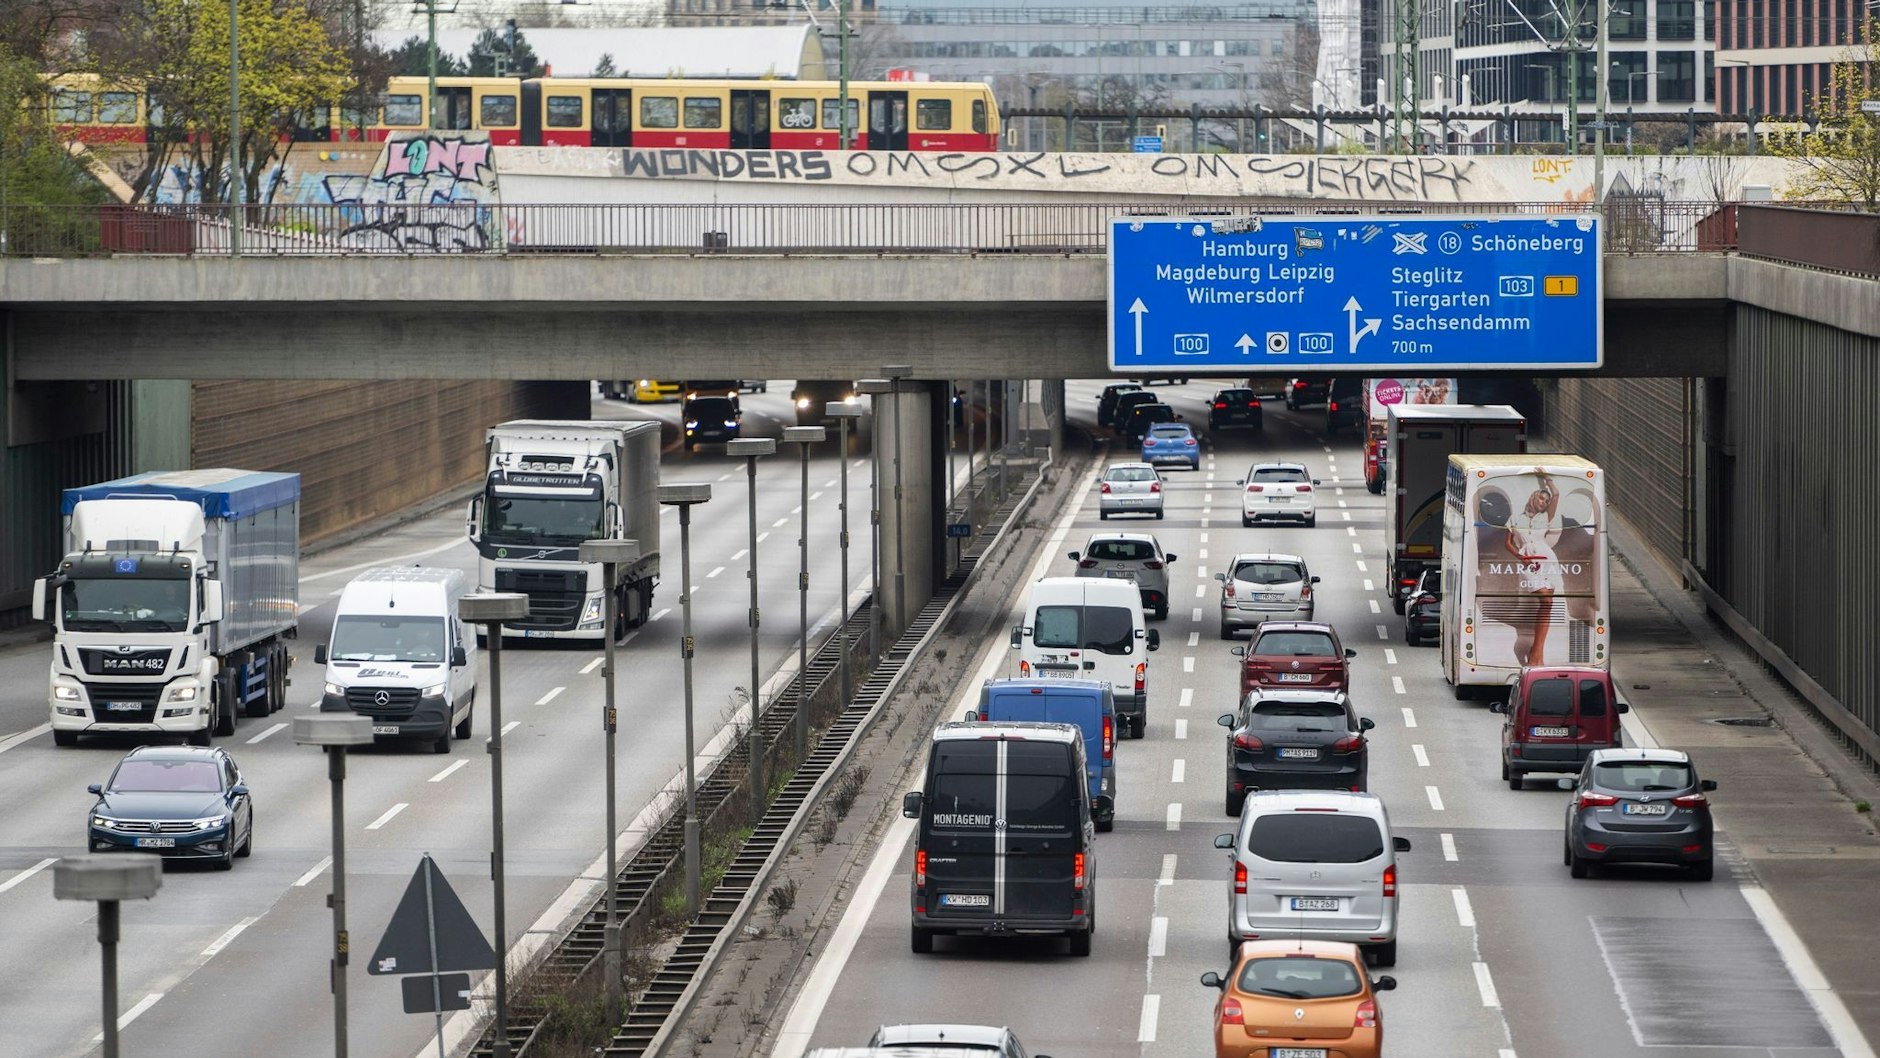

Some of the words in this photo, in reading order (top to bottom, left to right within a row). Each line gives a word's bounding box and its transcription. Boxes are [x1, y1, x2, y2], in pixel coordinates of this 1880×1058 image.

[622, 149, 832, 180] WONDERS
[1202, 240, 1288, 260] Hamburg
[1442, 237, 1457, 250] 18
[1471, 235, 1584, 254] Schöneberg
[1156, 264, 1261, 284] Magdeburg
[1268, 263, 1335, 283] Leipzig
[1391, 267, 1463, 288] Steglitz
[1505, 280, 1528, 293] 103
[1186, 287, 1305, 304] Wilmersdorf
[1391, 291, 1491, 311] Tiergarten
[1391, 314, 1531, 331] Sachsendamm
[1179, 338, 1203, 351] 100
[1304, 337, 1328, 350] 100
[1391, 341, 1417, 353] 700
[1419, 344, 1433, 353] m
[512, 476, 580, 485] GLOBETROTTER
[1489, 564, 1582, 575] MARCIANO
[104, 659, 144, 669] MAN
[145, 659, 164, 669] 482
[933, 814, 991, 825] MONTAGENIO
[1308, 900, 1319, 908] AZ
[1320, 900, 1335, 908] 268
